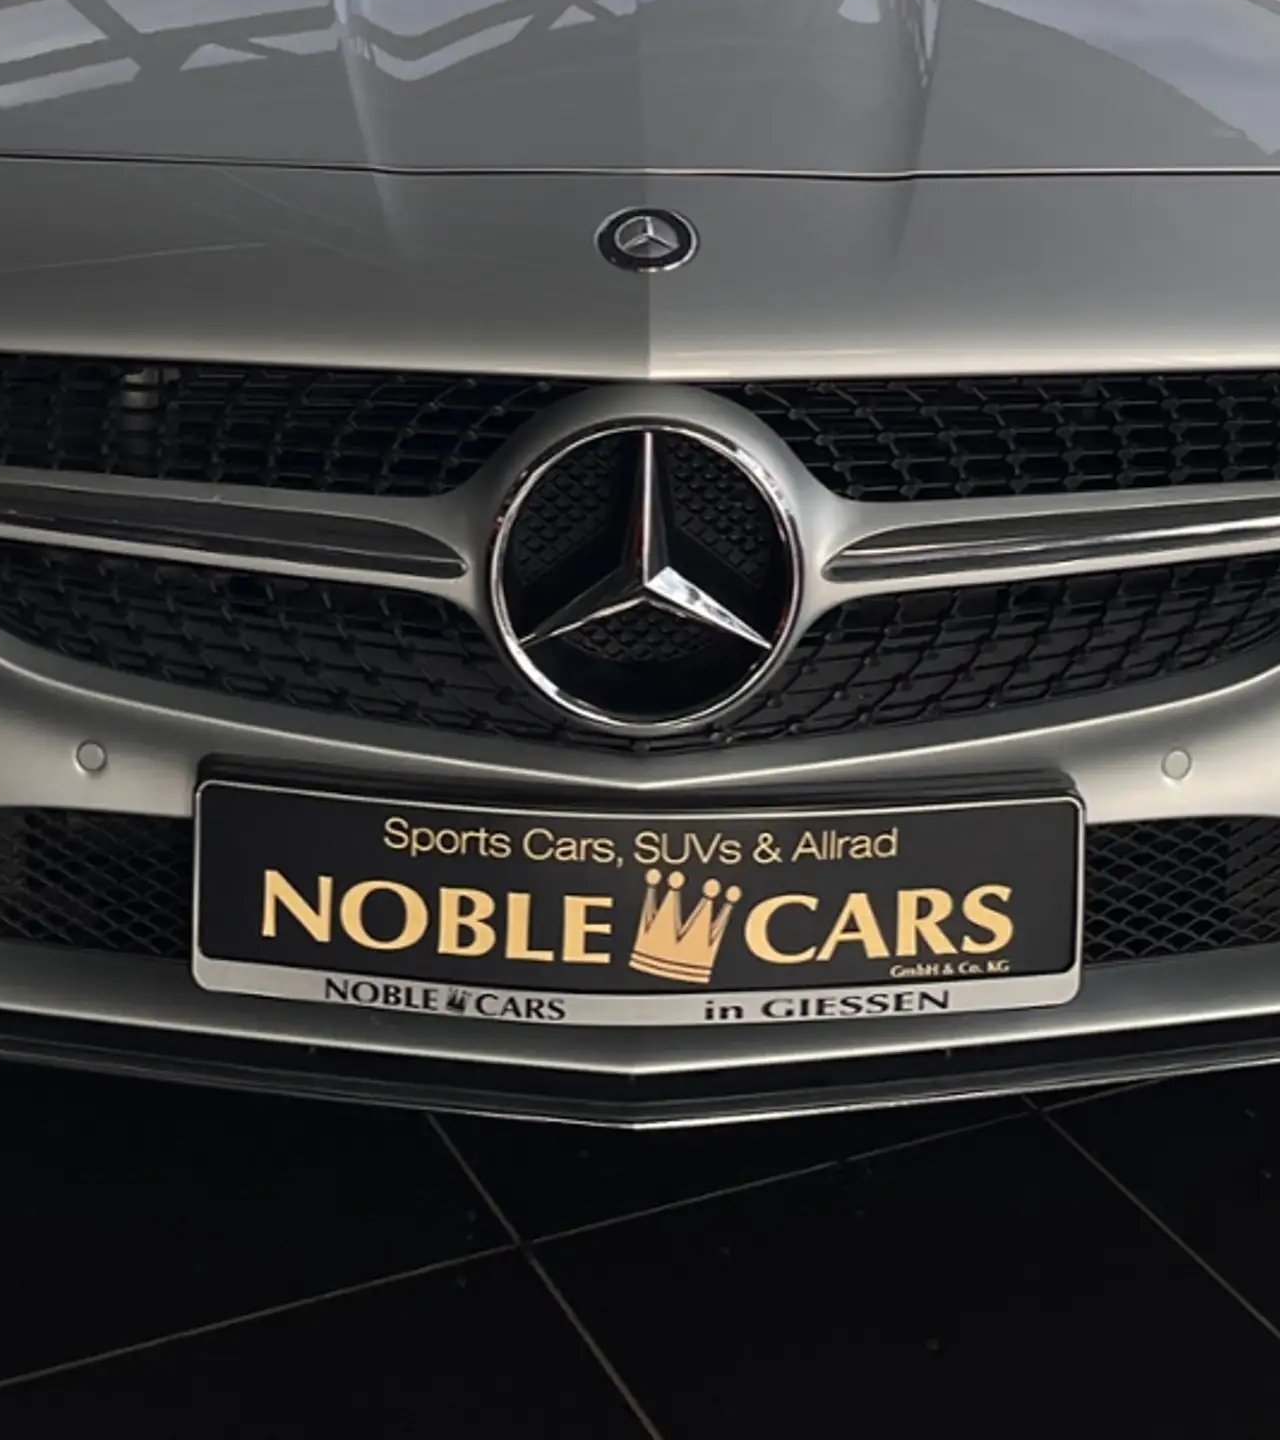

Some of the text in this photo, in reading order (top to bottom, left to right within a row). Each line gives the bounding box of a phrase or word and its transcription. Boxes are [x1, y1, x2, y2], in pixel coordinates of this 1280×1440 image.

[383, 816, 899, 868] Sports Cars, SUVs & Allrad
[262, 868, 1014, 964] NOBLE CARS
[889, 963, 940, 978] GmbH
[986, 959, 1010, 972] KG
[325, 976, 566, 1020] NOBLE CARS
[705, 989, 949, 1020] in GIESSEN
